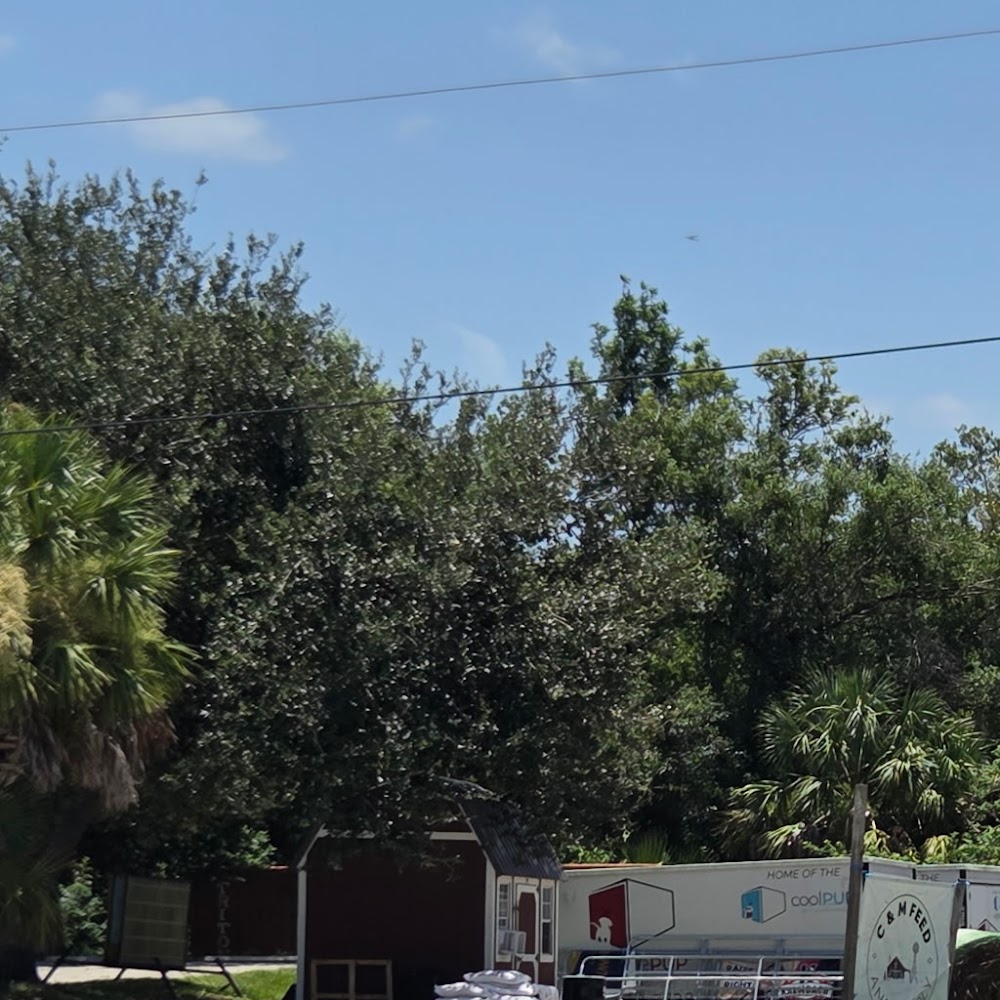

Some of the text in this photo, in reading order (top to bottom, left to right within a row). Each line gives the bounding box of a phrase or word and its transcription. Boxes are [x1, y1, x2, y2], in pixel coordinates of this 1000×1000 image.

[767, 867, 841, 880] HOME OF THE
[217, 881, 232, 954] TRITO
[877, 901, 932, 944] C & M FEED
